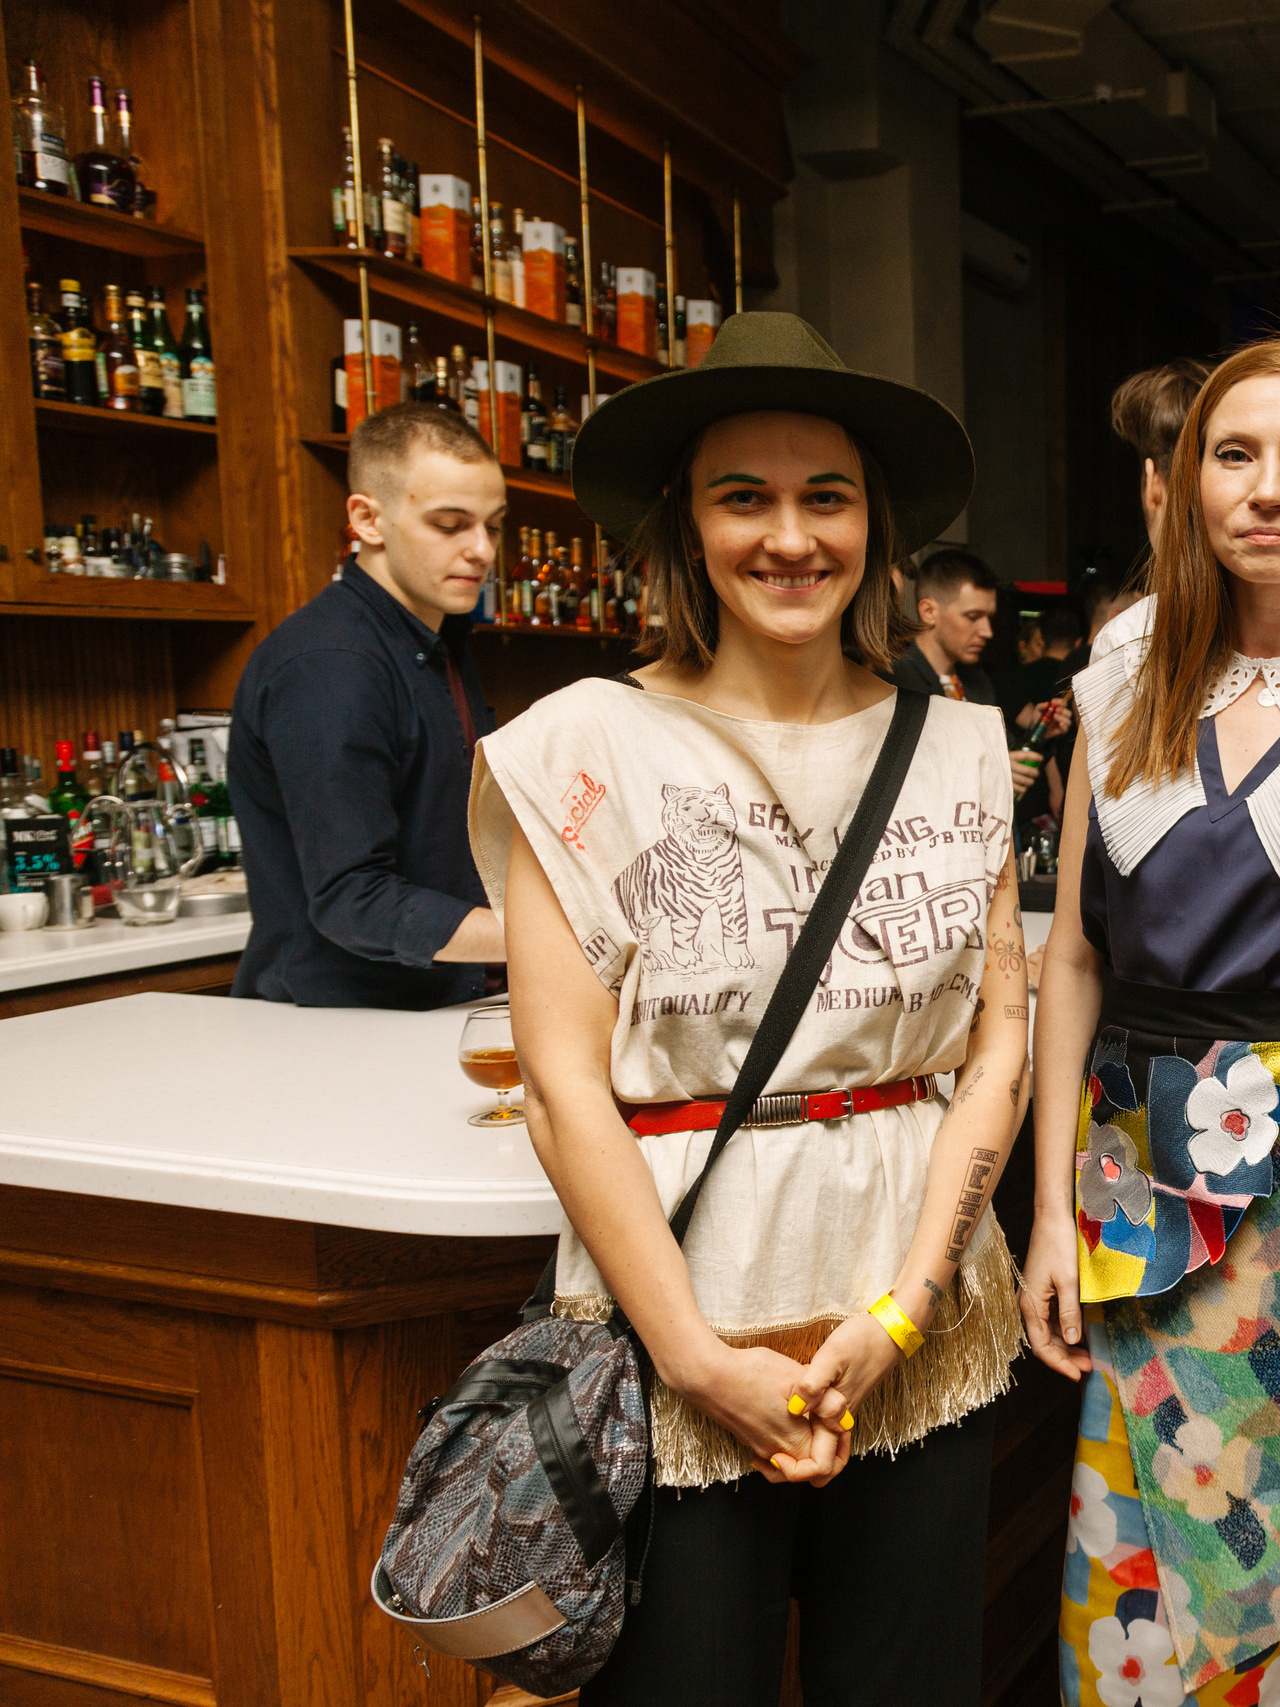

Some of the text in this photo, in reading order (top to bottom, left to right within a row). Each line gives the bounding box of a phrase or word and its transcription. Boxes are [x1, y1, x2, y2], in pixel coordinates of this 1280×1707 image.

[14, 852, 61, 872] 3.5%
[895, 846, 917, 859] BY
[761, 886, 985, 987] TGER
[660, 990, 753, 1016] QUALITY
[816, 985, 905, 1014] MEDIUM
[881, 1304, 900, 1327] CLUB
